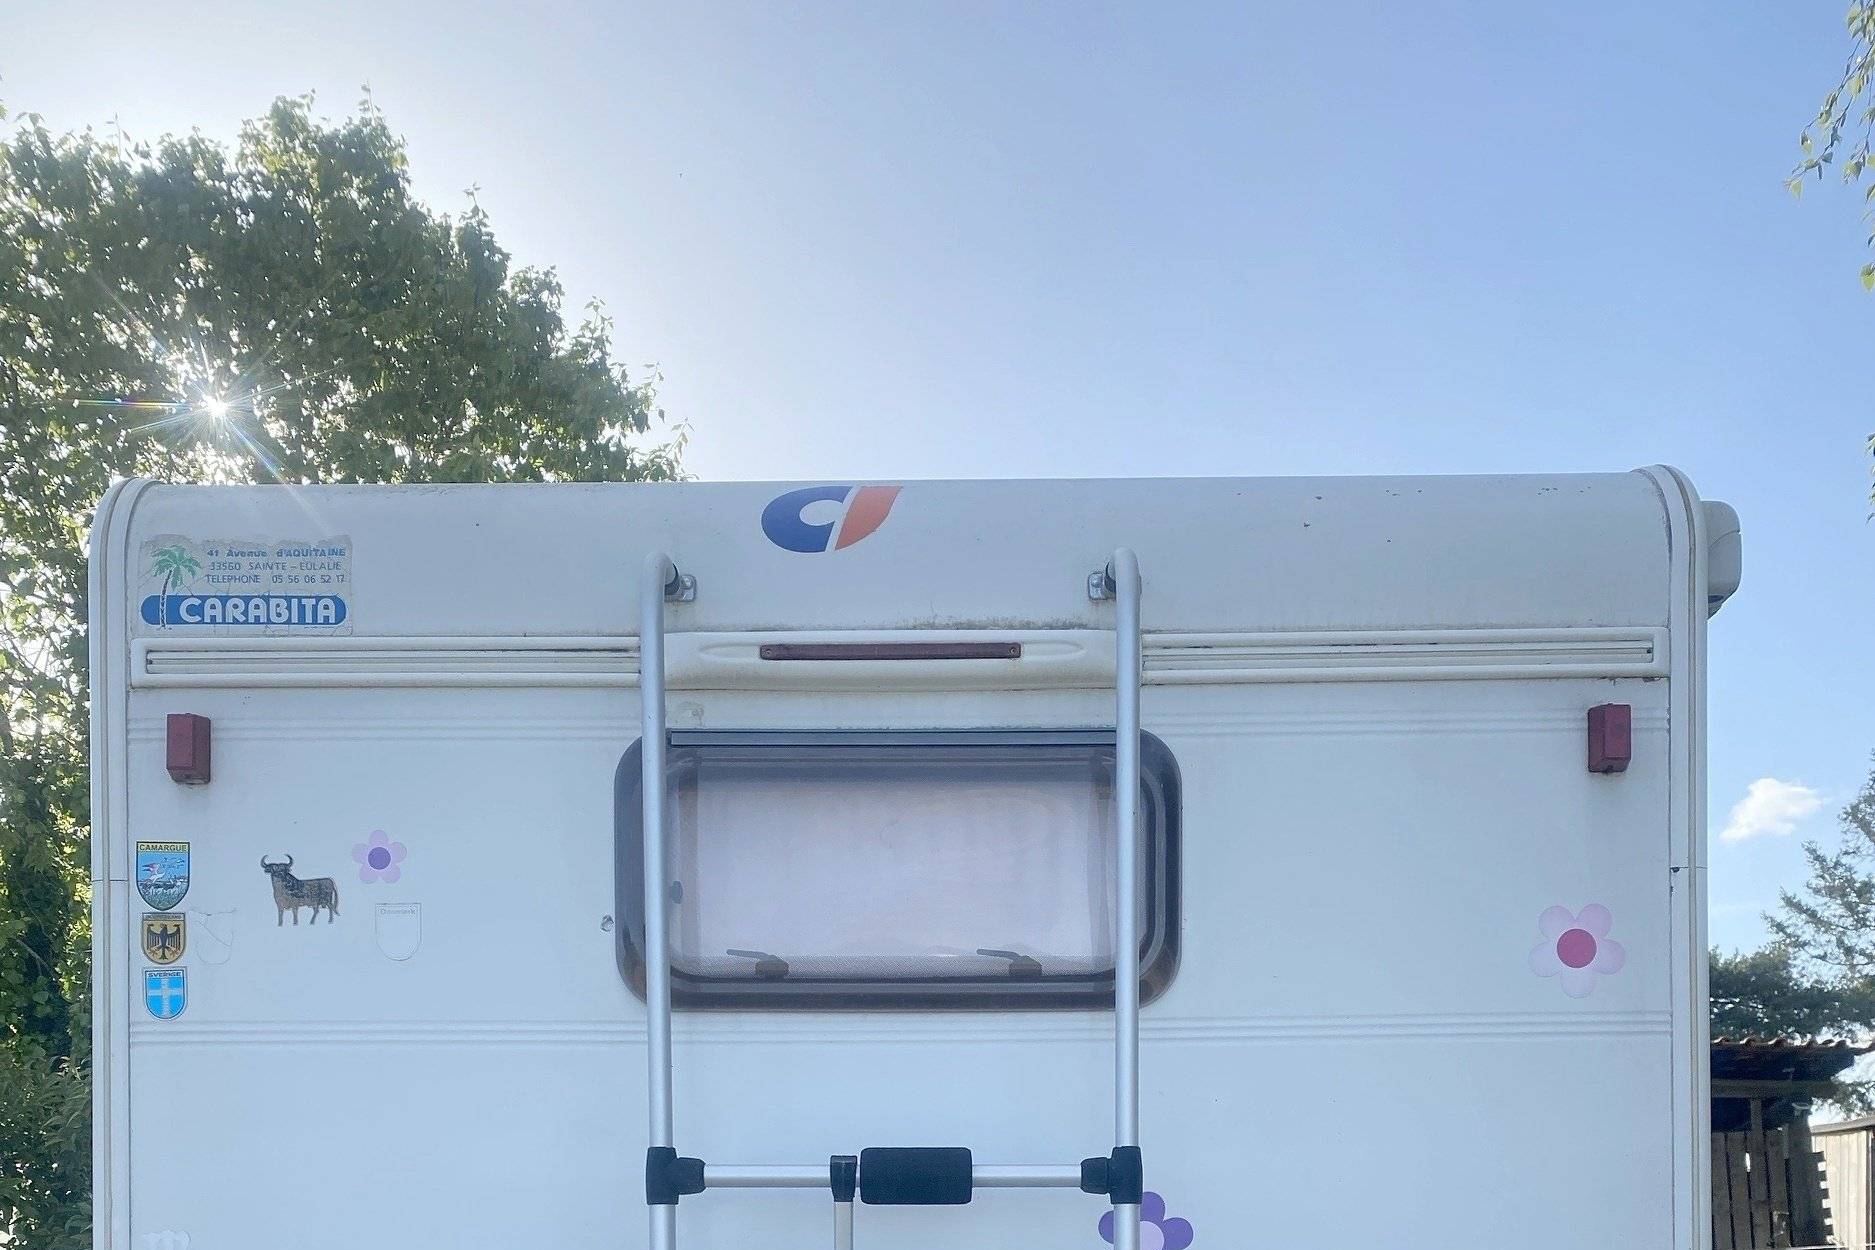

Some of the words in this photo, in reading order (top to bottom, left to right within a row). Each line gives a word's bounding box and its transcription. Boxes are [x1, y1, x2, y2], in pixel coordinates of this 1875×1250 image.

[210, 561, 241, 571] 33560
[249, 561, 287, 571] SAINTE
[300, 561, 342, 571] EULALIE
[205, 574, 261, 583] TELEPHONE
[271, 574, 283, 584] 05
[287, 574, 300, 584] 56
[304, 574, 316, 584] 06
[319, 574, 332, 584] 52
[179, 597, 336, 624] CARABITA
[139, 843, 187, 851] CAMARGUE
